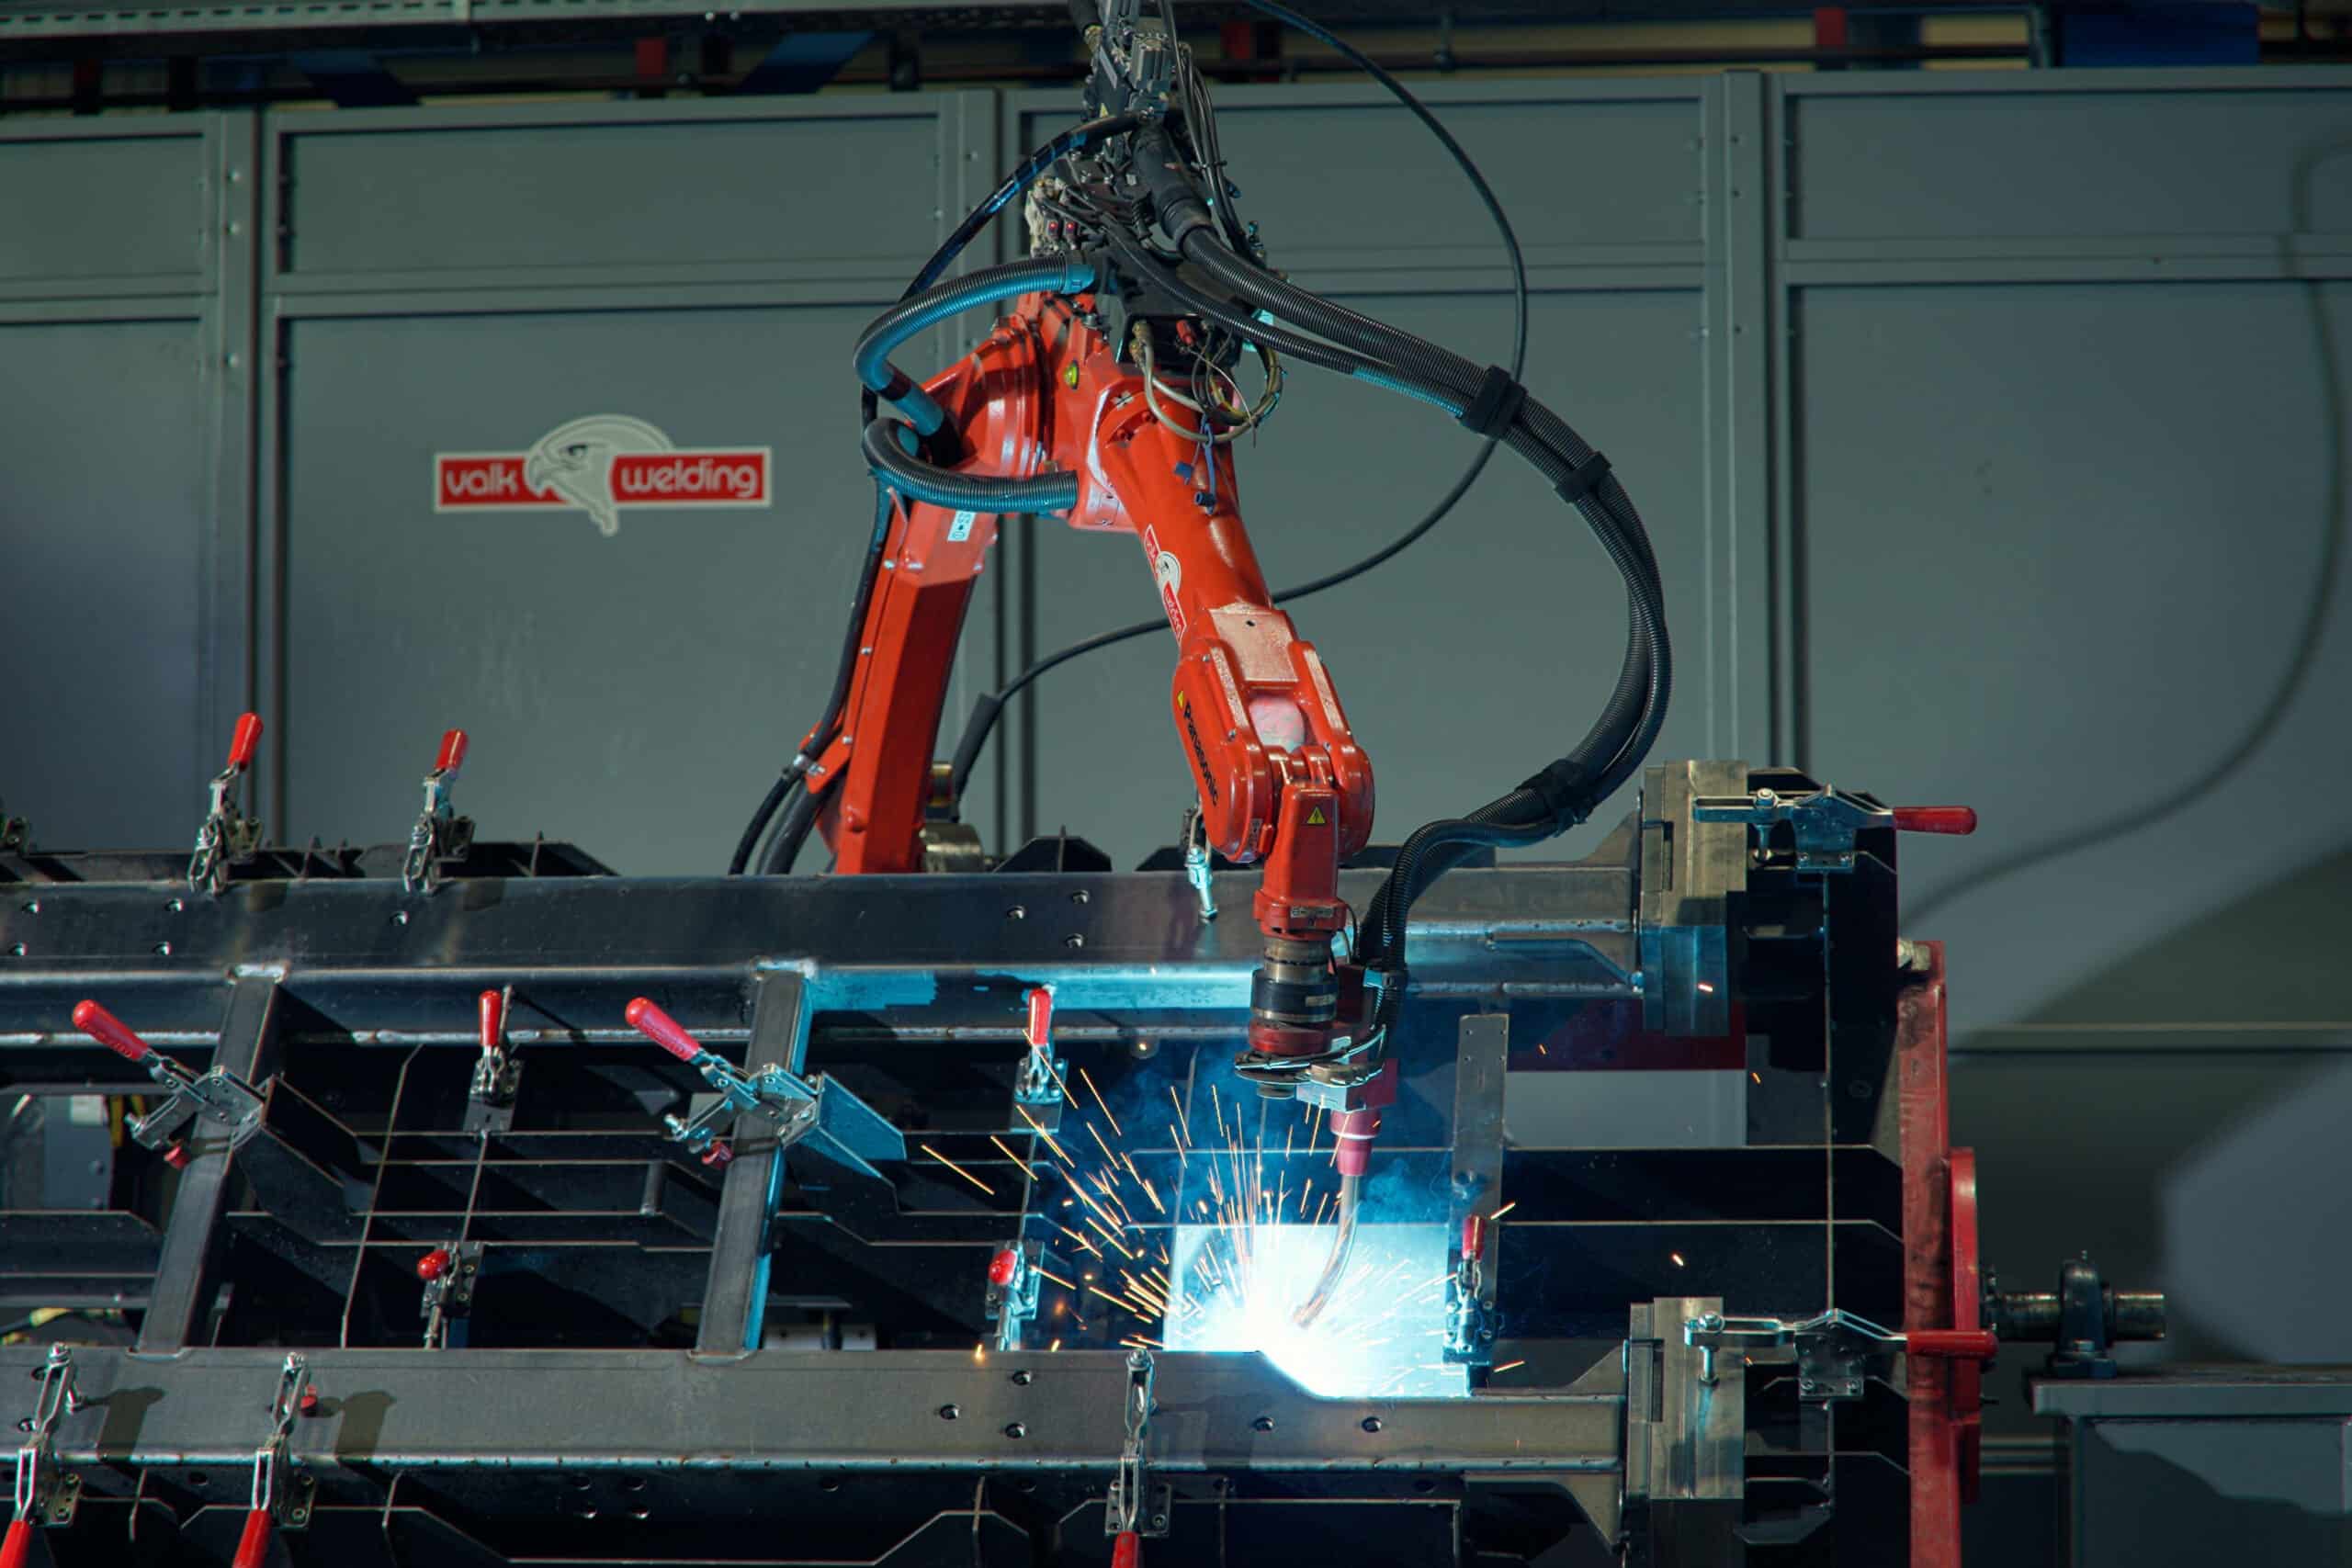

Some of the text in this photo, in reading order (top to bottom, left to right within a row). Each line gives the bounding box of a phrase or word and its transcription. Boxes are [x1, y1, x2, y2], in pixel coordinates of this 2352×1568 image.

[446, 457, 757, 498] valk welding
[1184, 701, 1218, 807] Panasonic
